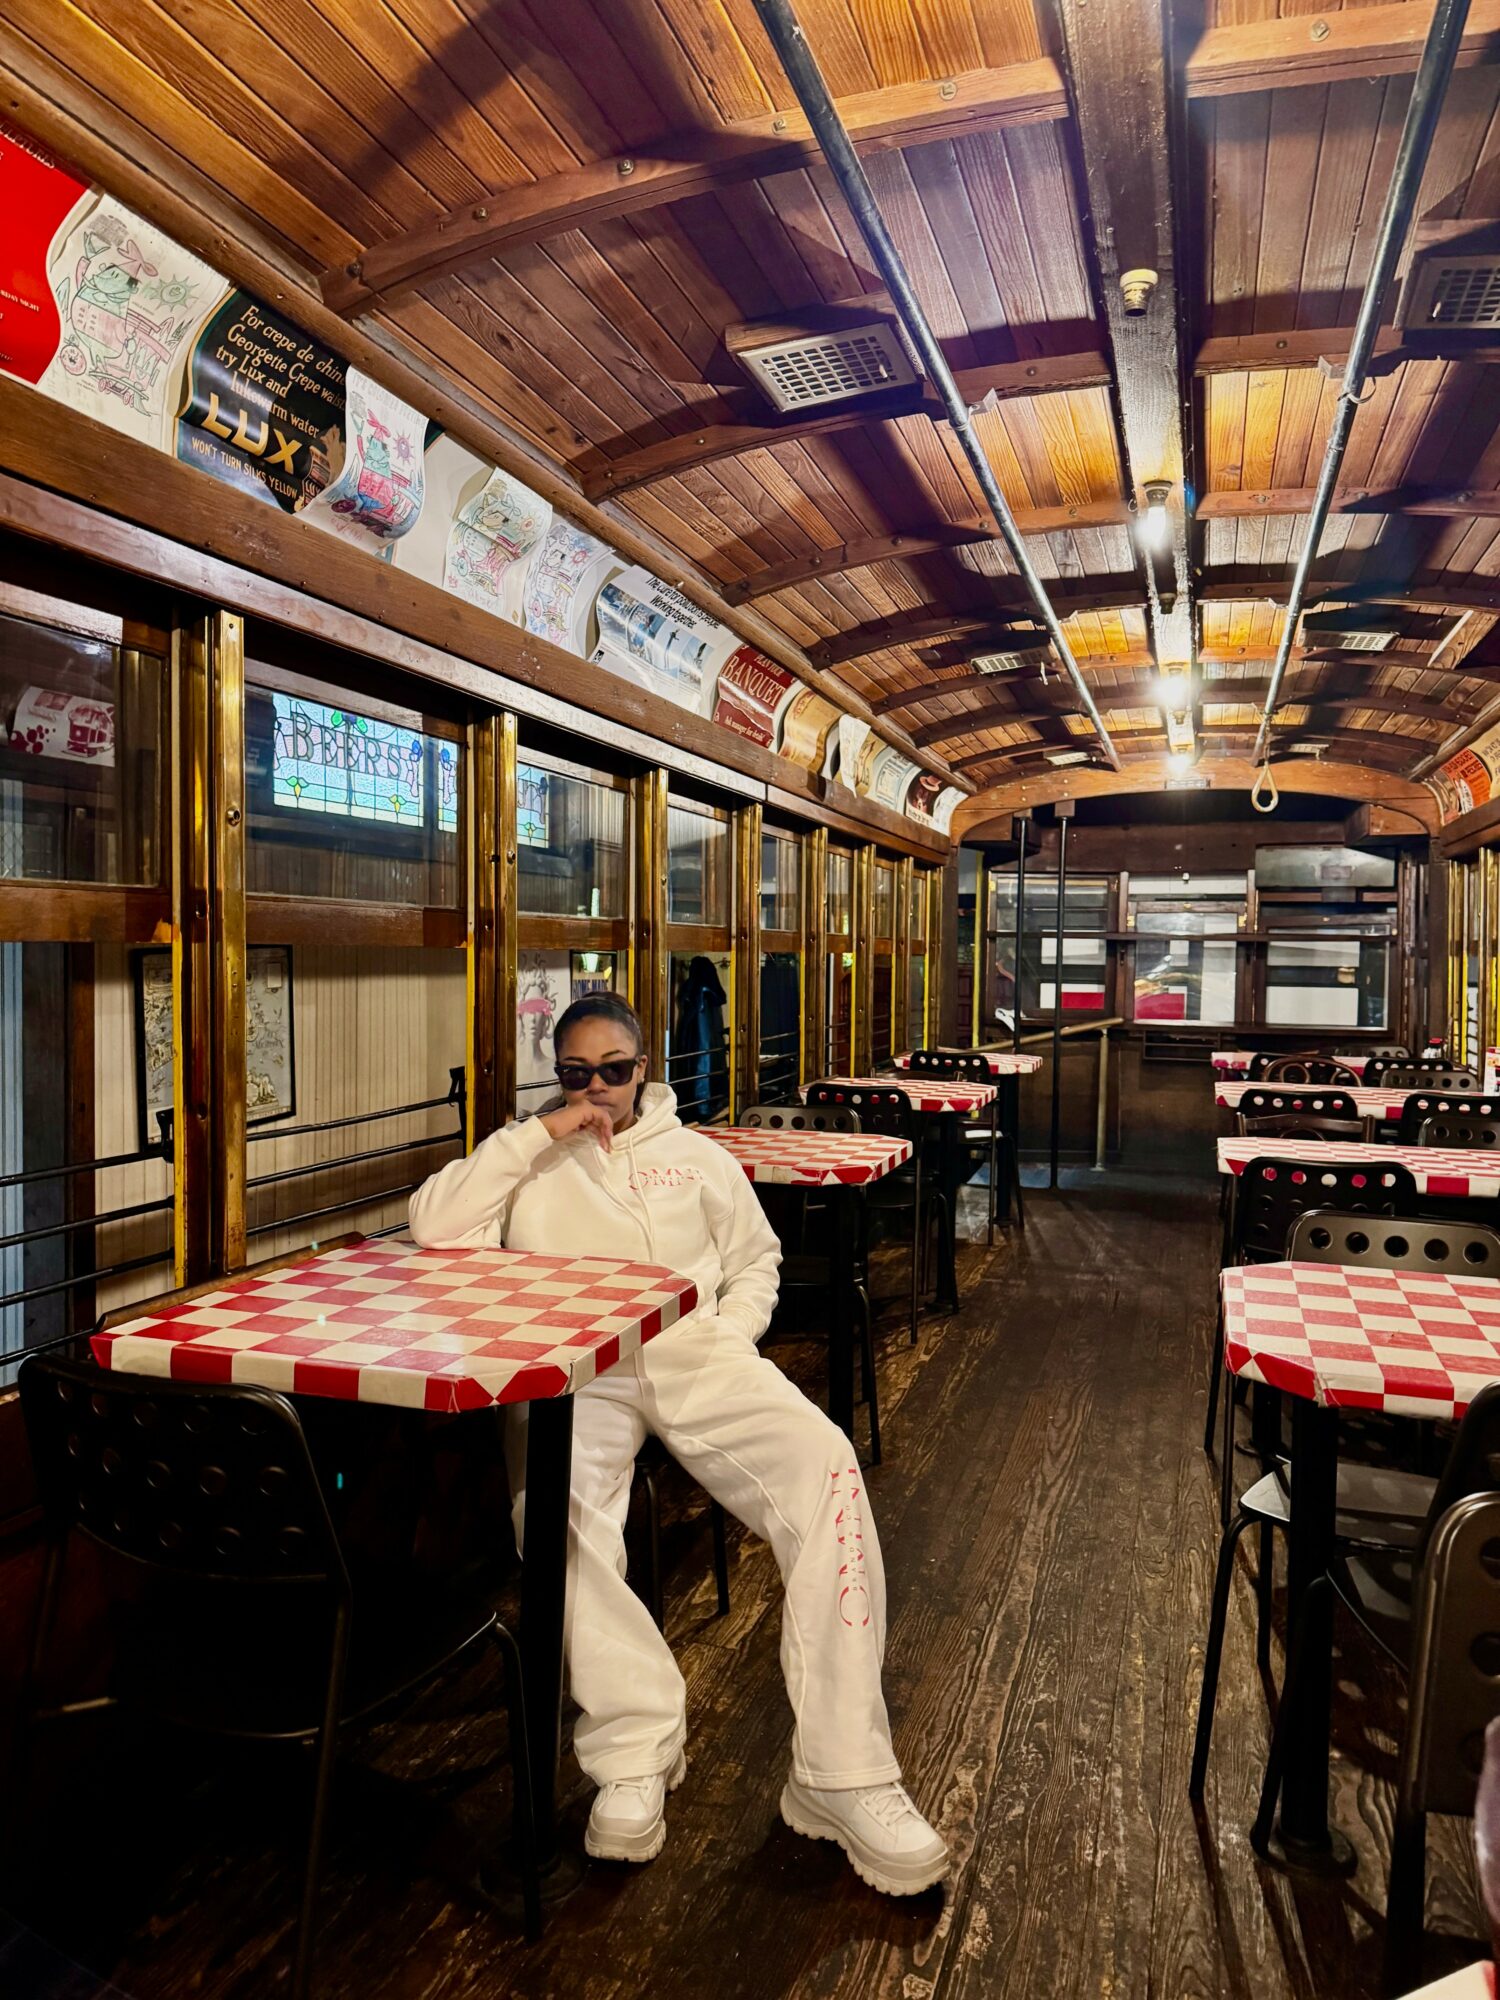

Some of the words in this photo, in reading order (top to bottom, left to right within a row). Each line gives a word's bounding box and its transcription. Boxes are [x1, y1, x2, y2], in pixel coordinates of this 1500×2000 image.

[227, 323, 288, 373] Georgette
[288, 362, 321, 394] Crepe
[240, 305, 265, 330] For
[262, 326, 297, 351] crepe
[297, 344, 315, 362] de
[215, 345, 238, 368] try
[238, 354, 266, 384] Lux
[265, 378, 293, 399] and
[201, 392, 302, 475] LUX
[230, 371, 287, 421] lukewarm
[290, 412, 320, 439] water
[191, 436, 218, 460] WON'T
[220, 451, 242, 472] TURN
[243, 461, 267, 485] SILKS
[268, 475, 299, 500] YELLOW
[645, 575, 660, 588] The
[657, 584, 673, 597] cure
[649, 594, 676, 618] Working
[721, 655, 787, 707] BANQUET
[291, 712, 402, 778] BEERS
[849, 1546, 858, 1591] BRAND
